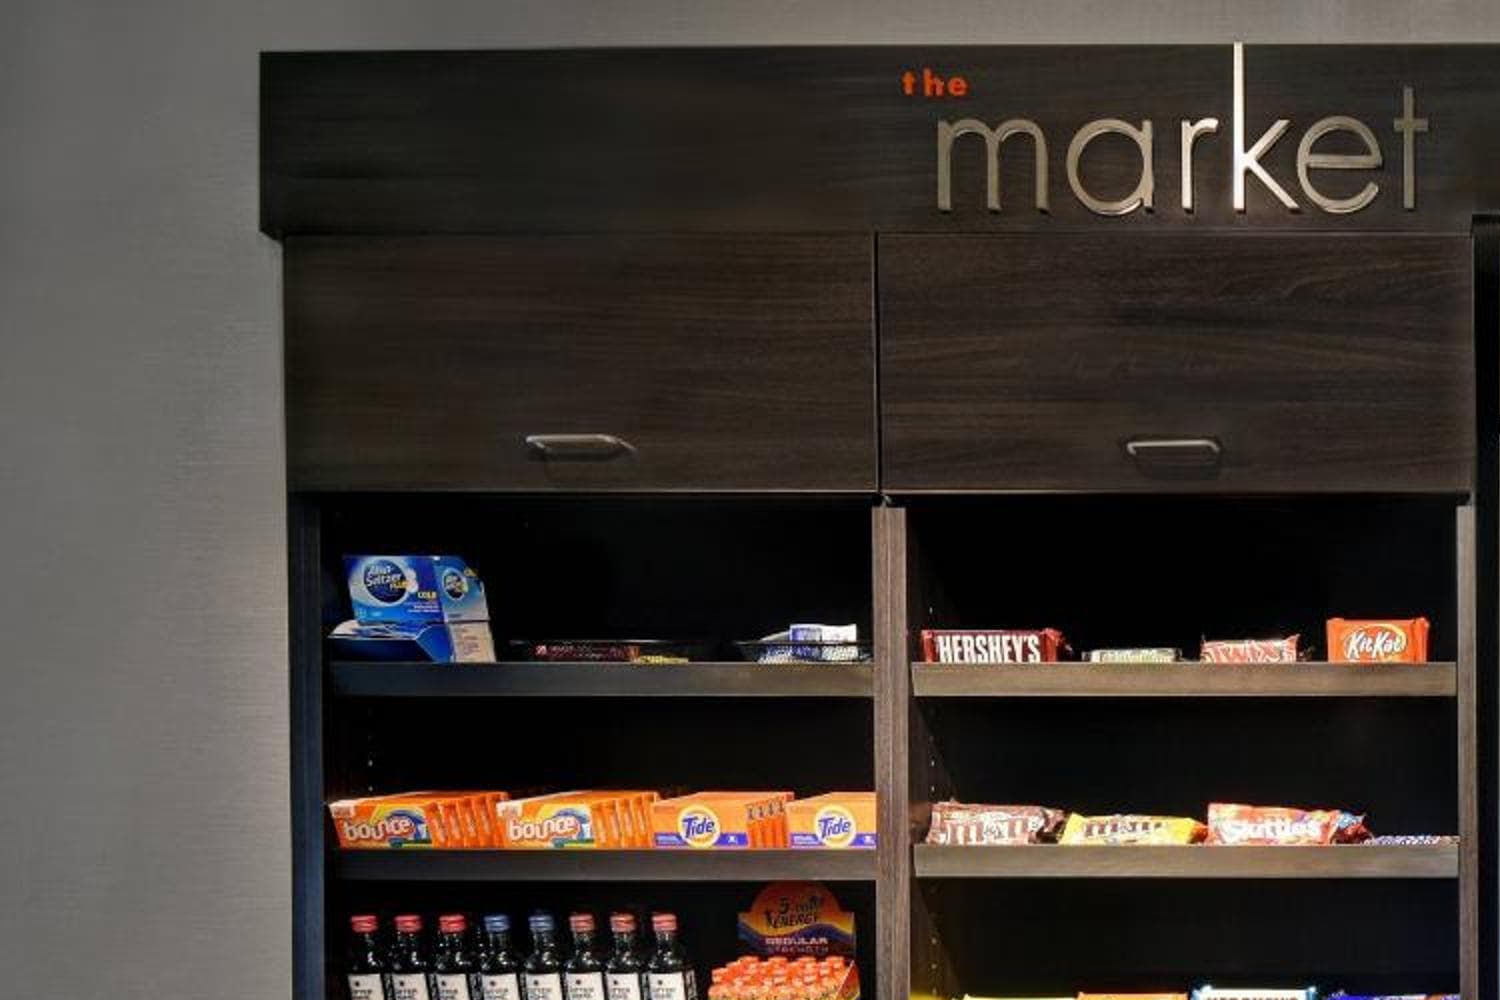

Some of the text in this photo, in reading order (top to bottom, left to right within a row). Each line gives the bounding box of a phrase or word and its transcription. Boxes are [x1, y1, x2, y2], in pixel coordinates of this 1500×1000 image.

[902, 68, 970, 98] the
[936, 41, 1430, 215] market
[937, 634, 1041, 664] HERSHEY'S
[343, 816, 416, 841] bounce
[508, 815, 580, 841] bounce
[682, 816, 716, 838] Tide
[817, 816, 851, 838] Tide
